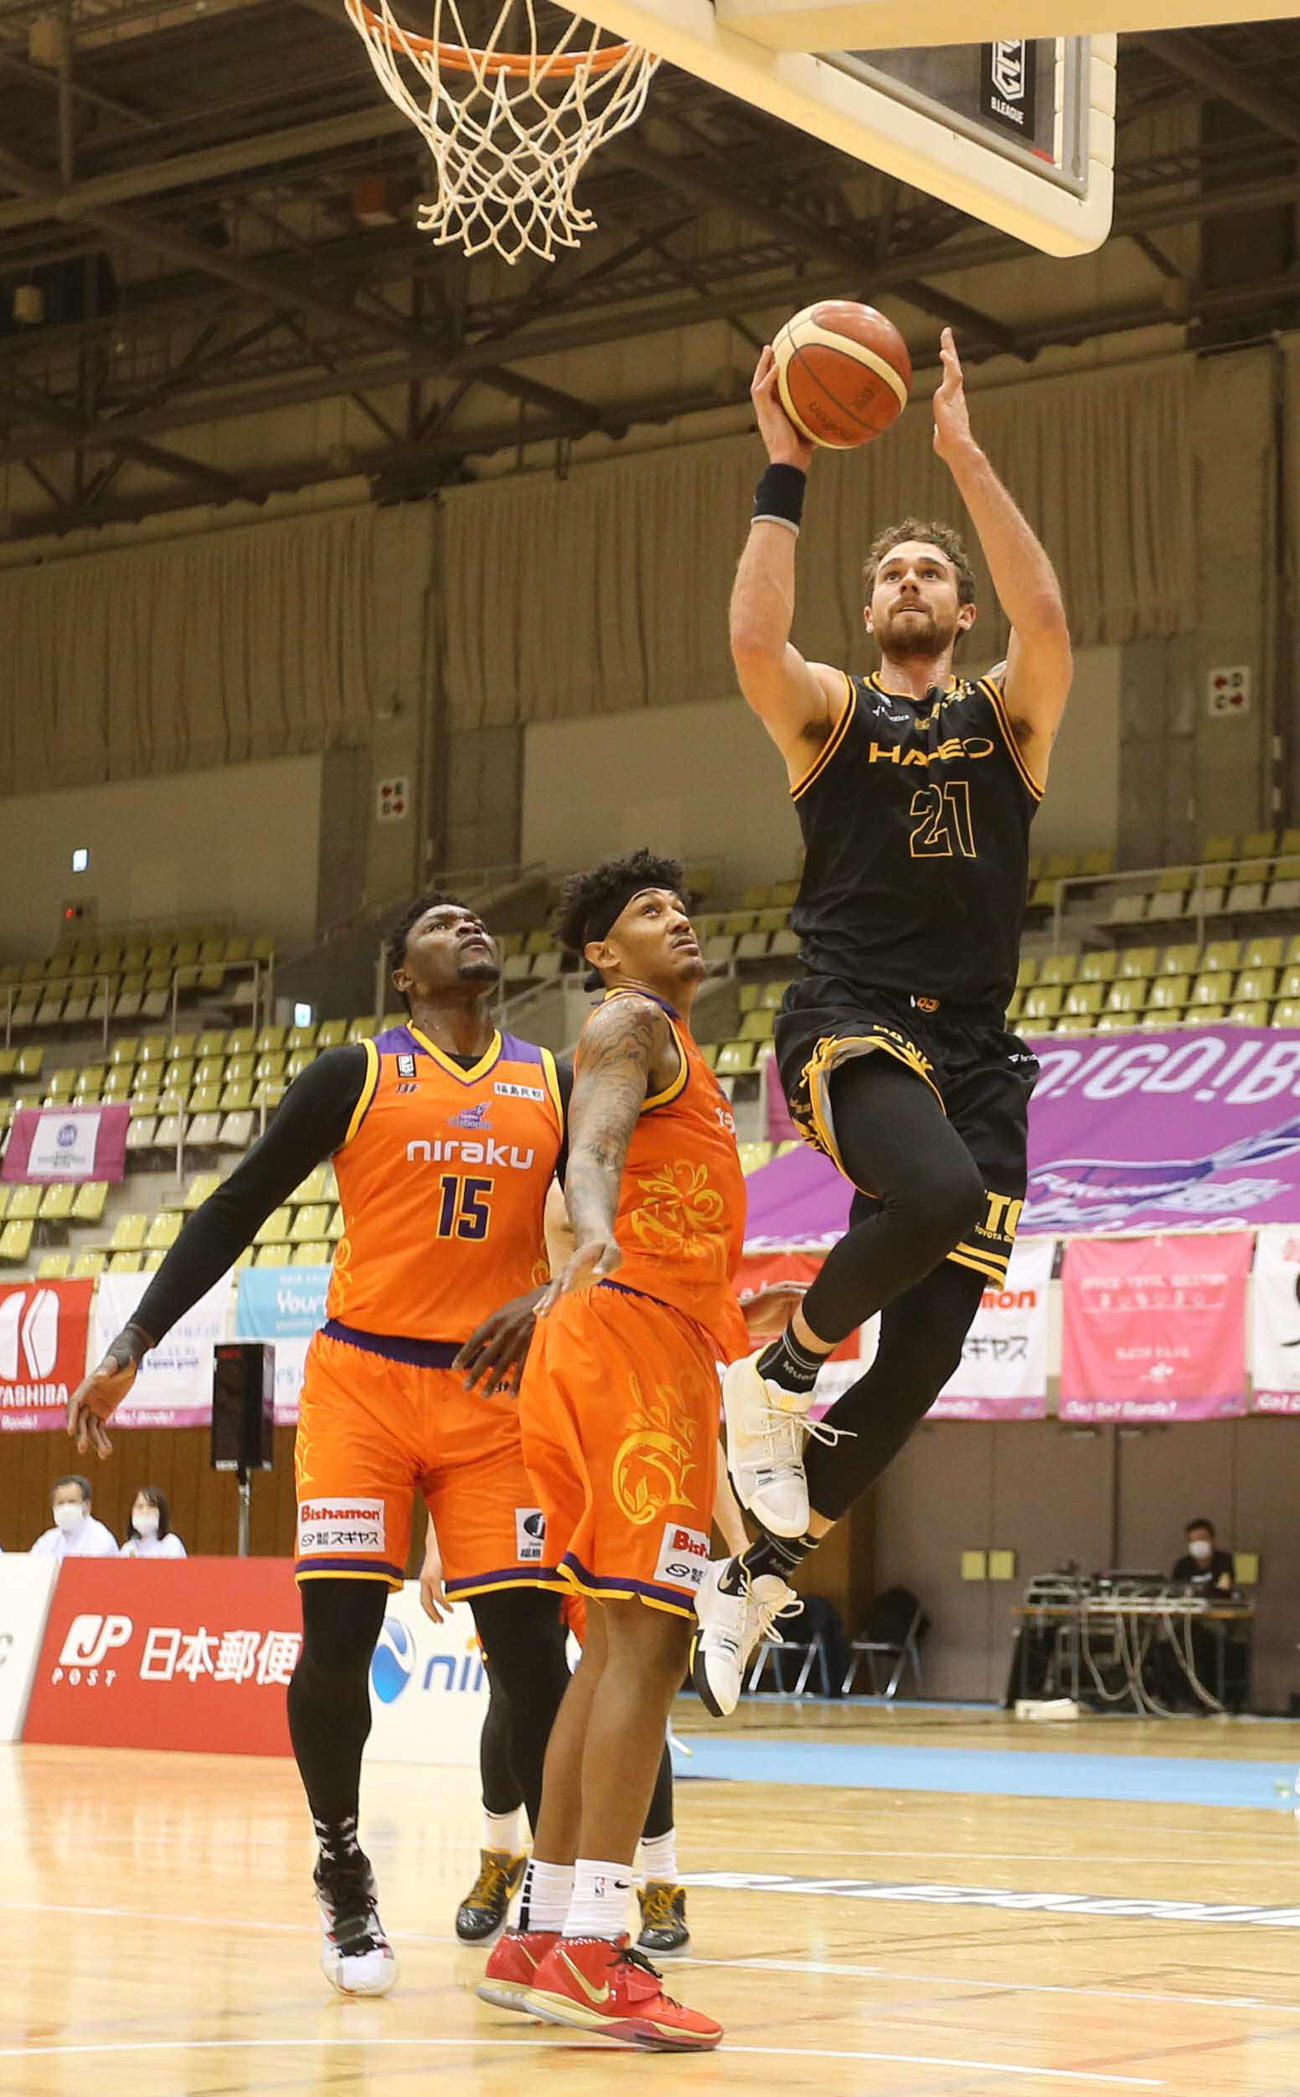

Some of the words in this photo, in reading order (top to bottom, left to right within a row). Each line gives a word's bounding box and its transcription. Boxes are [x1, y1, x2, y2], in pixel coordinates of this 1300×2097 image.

[910, 781, 977, 858] 21
[406, 1138, 535, 1170] niraku
[436, 1173, 496, 1242] 15
[961, 1335, 1029, 1361] ギヤス
[301, 1505, 380, 1522] Bishamon
[331, 1531, 379, 1545] スギヤス
[59, 1614, 133, 1667] JP
[139, 1627, 302, 1686] 日本郵便
[51, 1668, 117, 1687] POST
